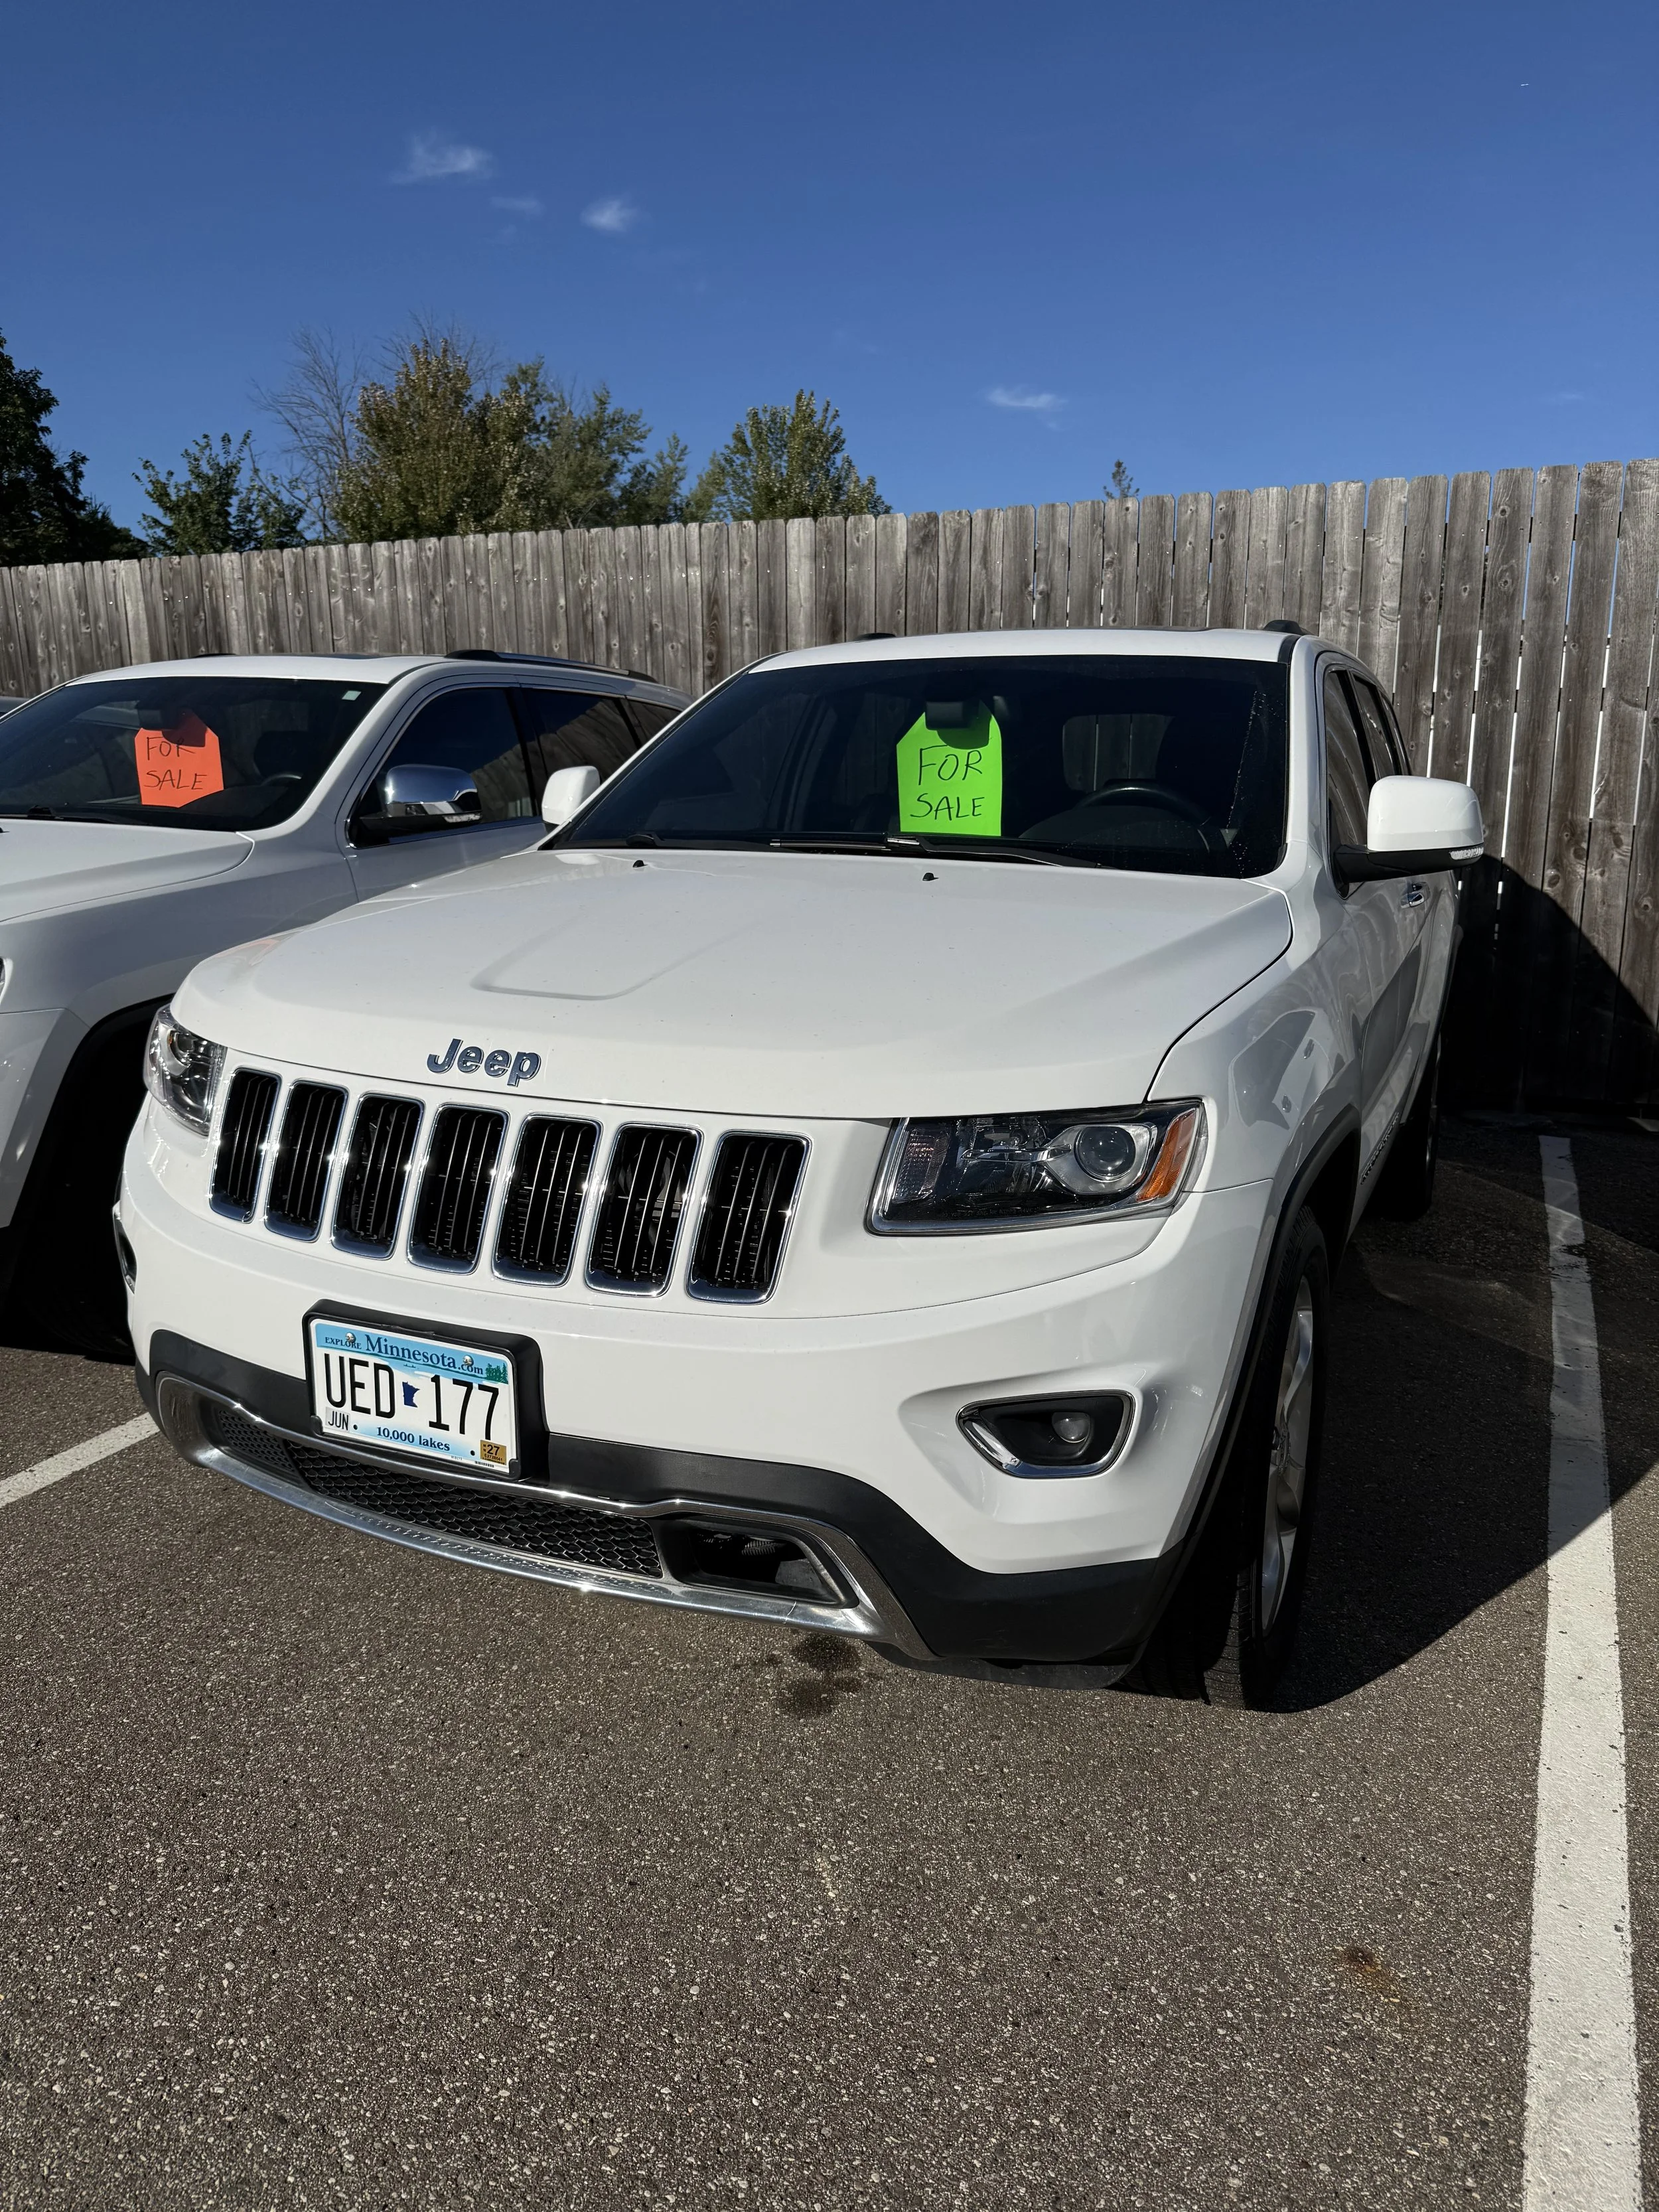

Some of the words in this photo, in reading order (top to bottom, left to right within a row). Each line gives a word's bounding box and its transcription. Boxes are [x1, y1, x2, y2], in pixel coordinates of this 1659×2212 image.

[147, 736, 196, 761] FOR
[918, 745, 983, 786] FOR
[143, 769, 208, 791] SALE
[910, 792, 985, 821] SALE
[427, 1038, 541, 1088] Jeep
[325, 1336, 362, 1350] EXPLORE
[365, 1334, 484, 1375] Minnesota.com
[324, 1353, 396, 1419] UED
[428, 1374, 500, 1441] 177
[328, 1410, 349, 1431] JUN
[377, 1426, 415, 1444] 10,000
[418, 1435, 451, 1452] lakes
[487, 1443, 500, 1456] 27
